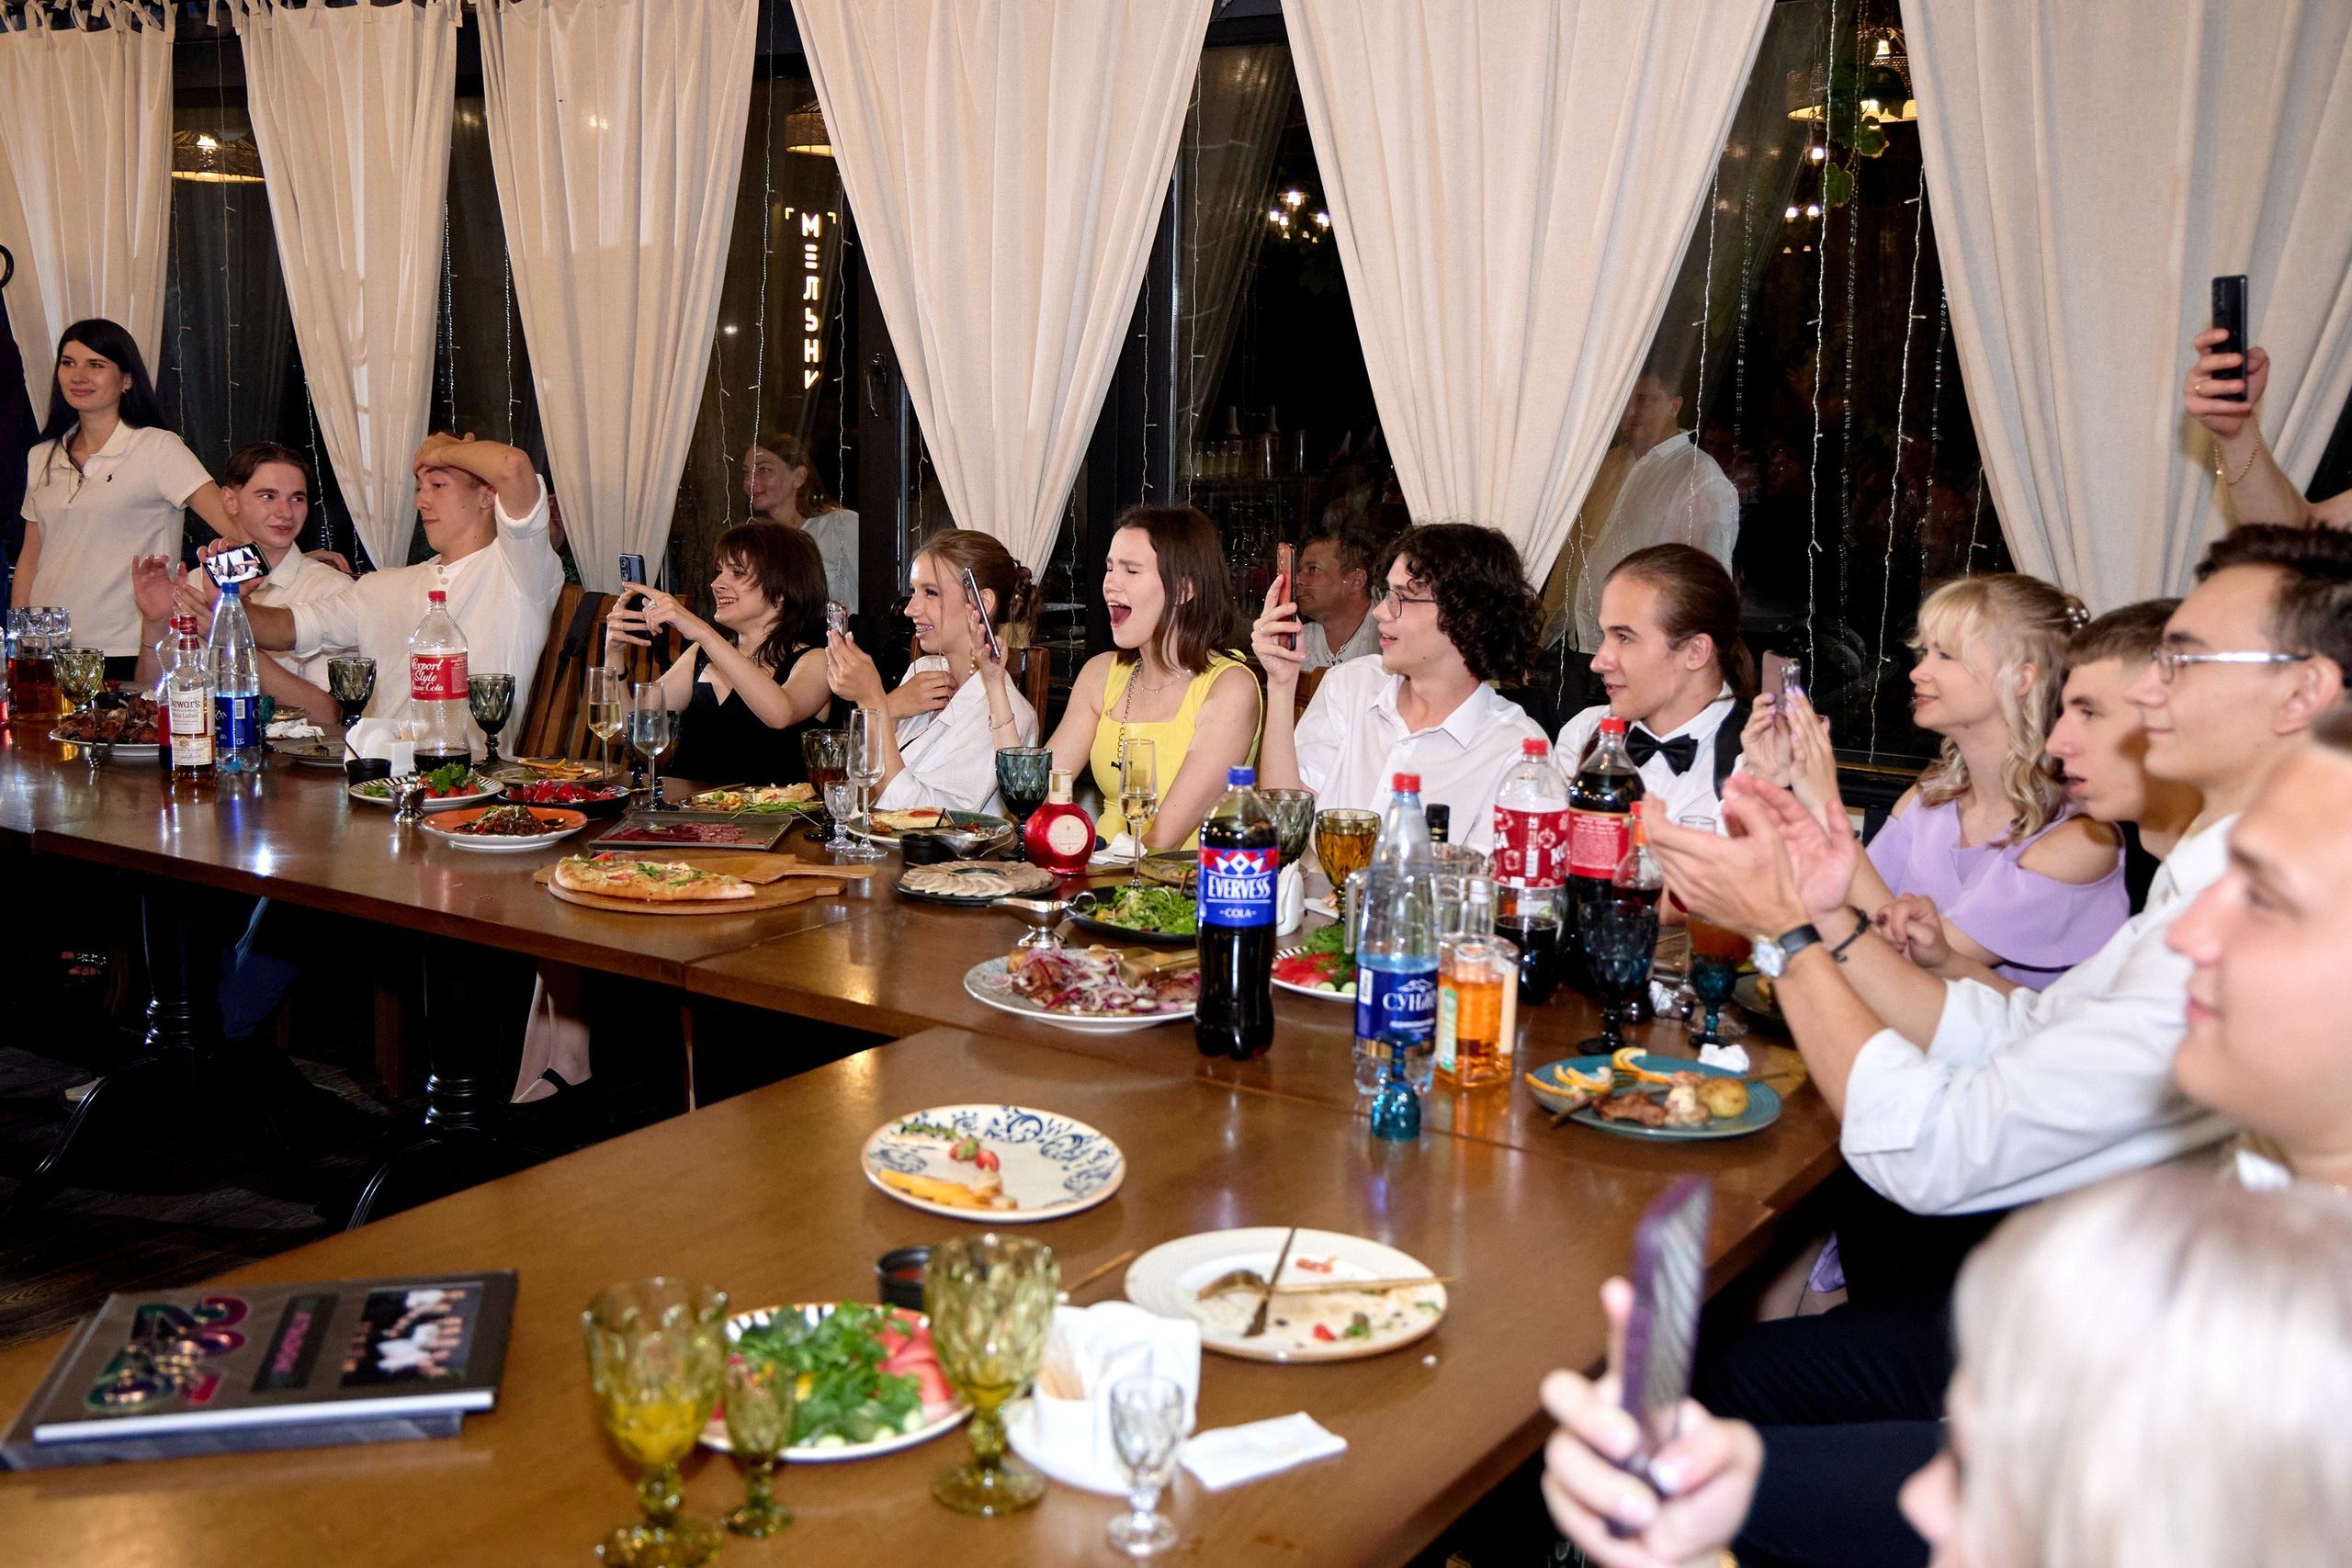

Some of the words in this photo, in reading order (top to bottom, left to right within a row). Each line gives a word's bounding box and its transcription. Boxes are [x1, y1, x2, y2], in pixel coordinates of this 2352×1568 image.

[412, 658, 444, 675] Export
[414, 670, 437, 685] Style
[425, 682, 445, 692] Cola
[1207, 874, 1272, 899] EVERVESS
[1224, 908, 1252, 919] COLA
